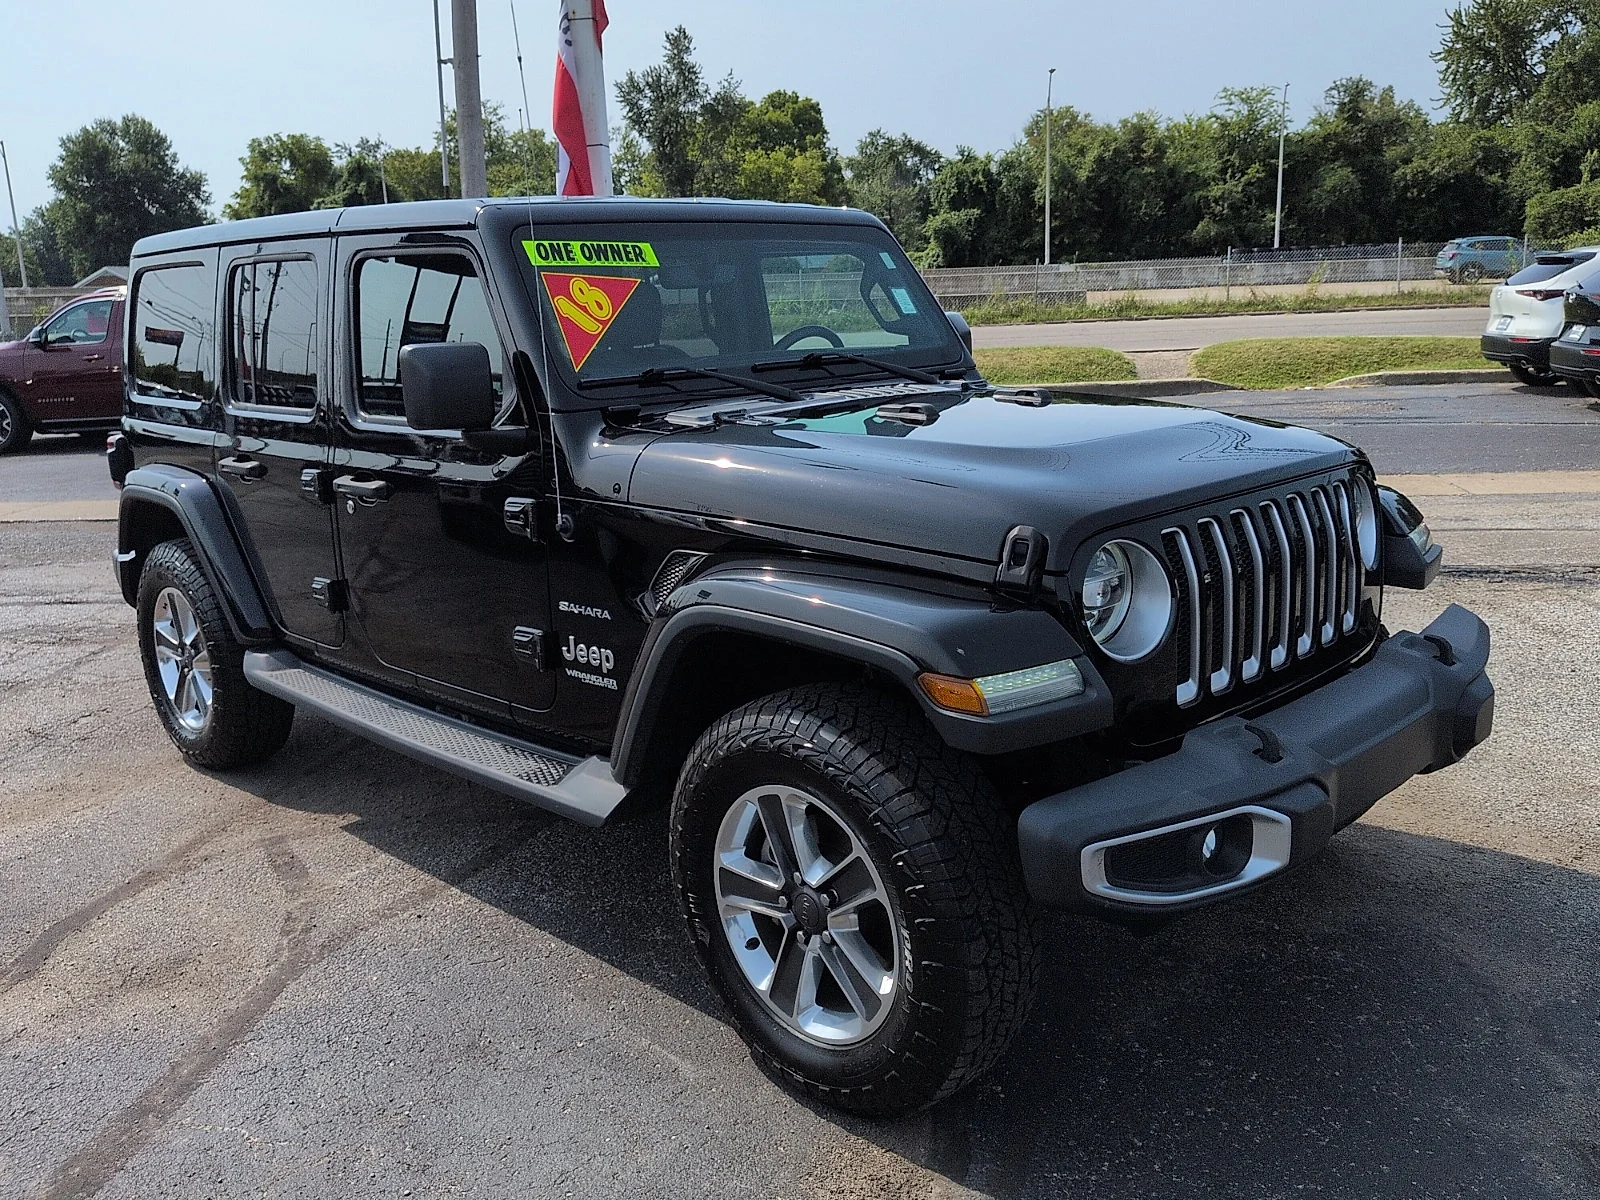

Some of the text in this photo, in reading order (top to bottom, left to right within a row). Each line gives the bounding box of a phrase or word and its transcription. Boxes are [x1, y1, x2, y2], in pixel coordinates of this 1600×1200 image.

[535, 243, 647, 264] ONE OWNER
[554, 277, 613, 335] 18
[558, 600, 612, 620] SAHARA
[561, 635, 614, 674] Jeep
[565, 667, 617, 687] WRANGLER
